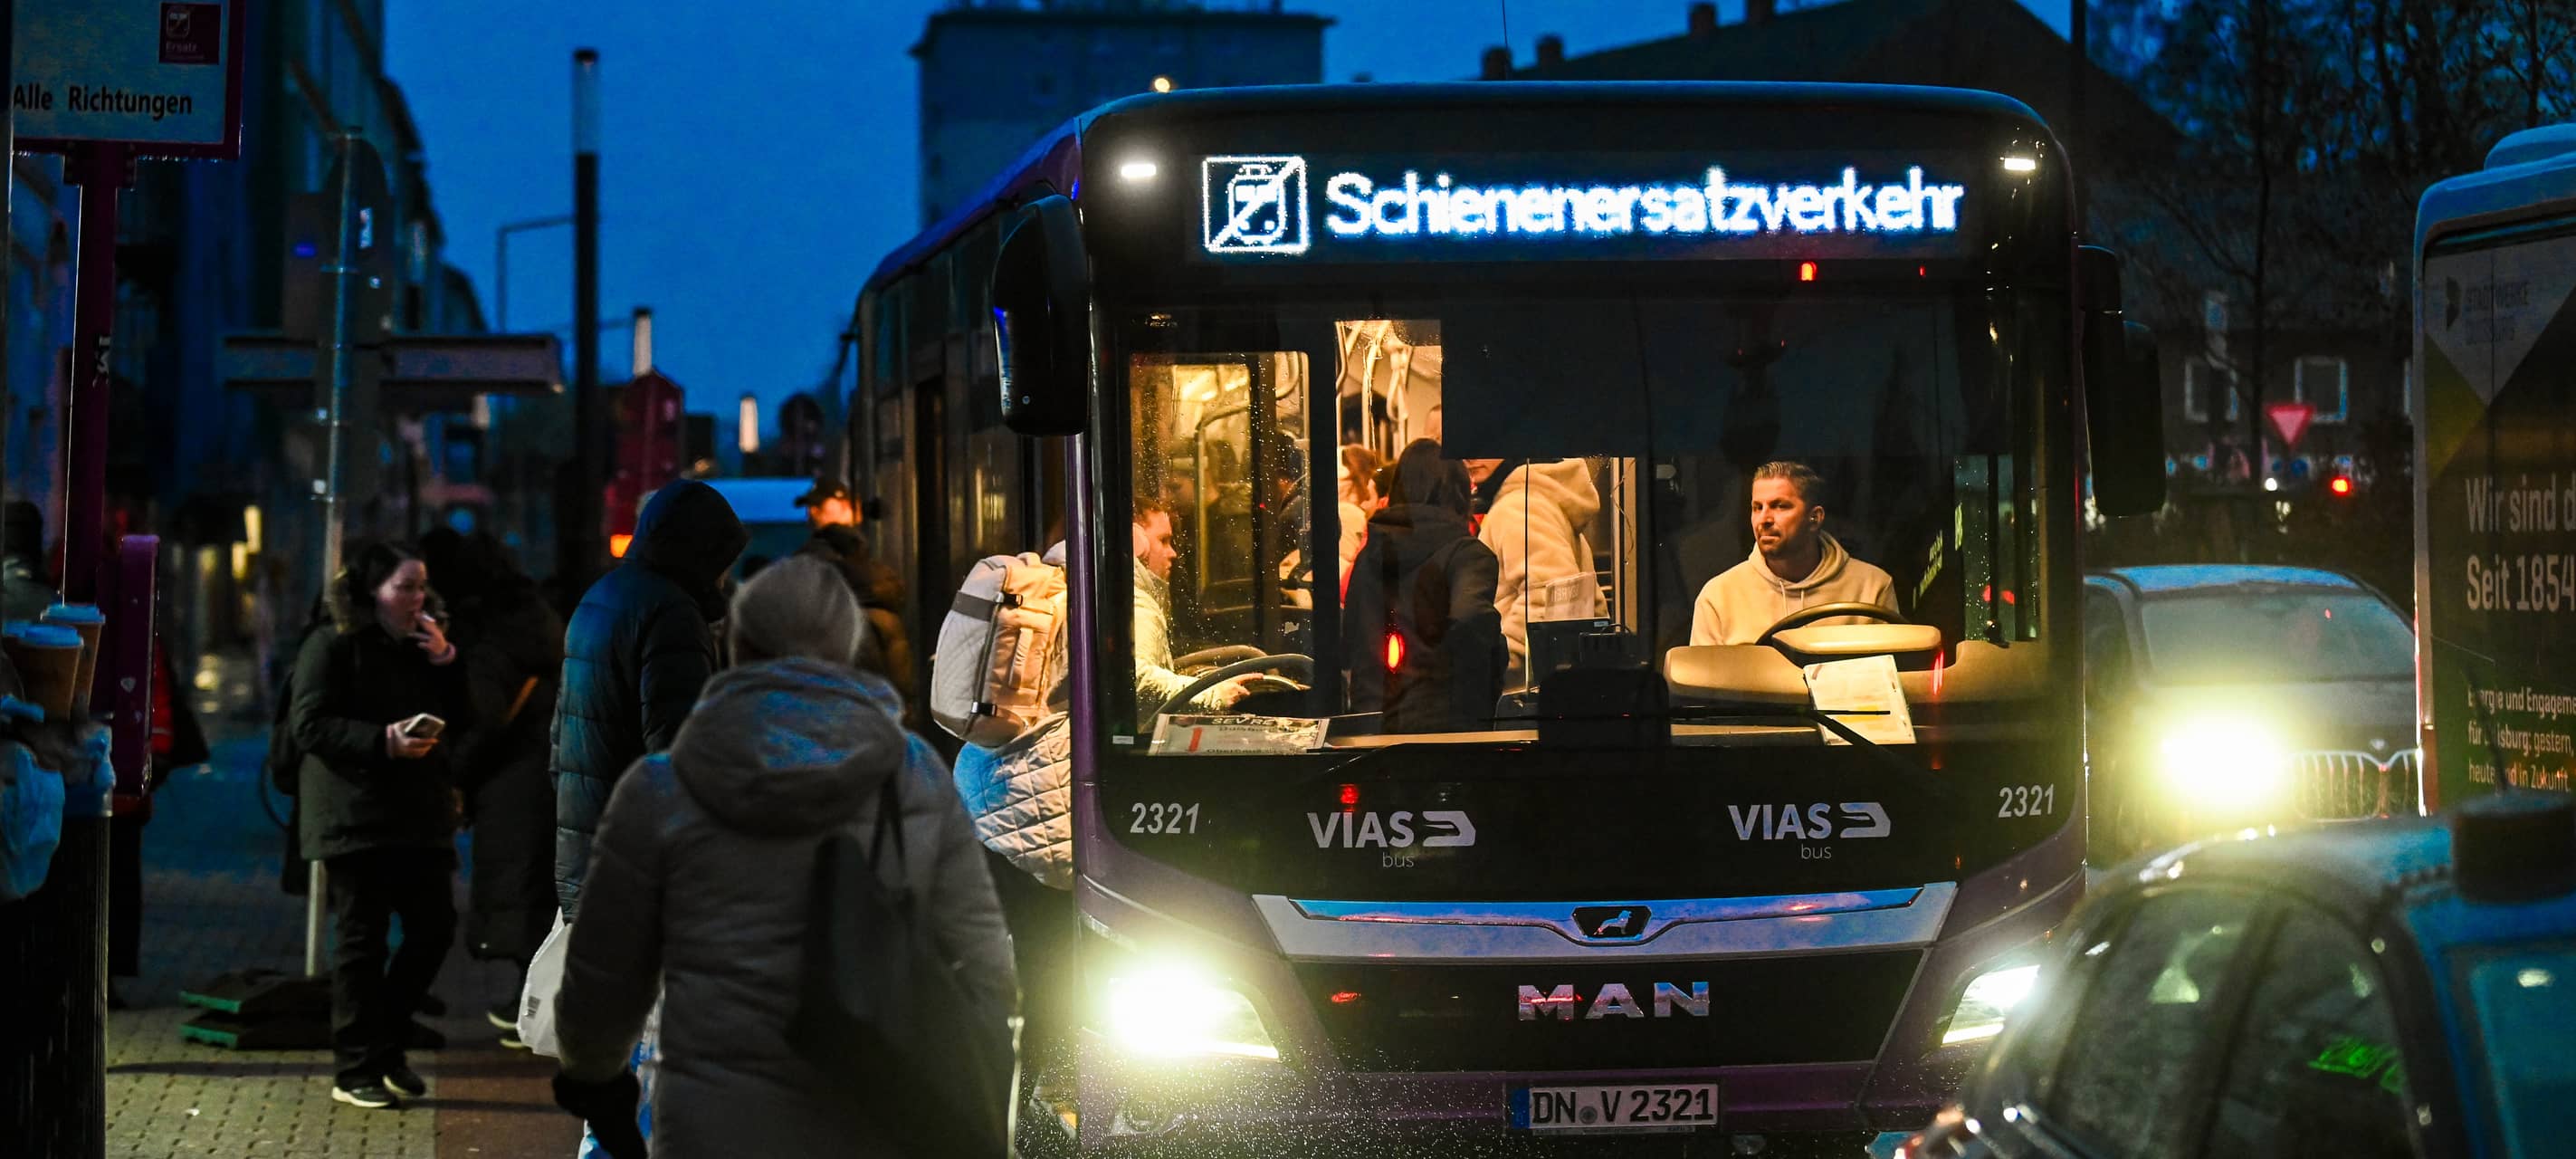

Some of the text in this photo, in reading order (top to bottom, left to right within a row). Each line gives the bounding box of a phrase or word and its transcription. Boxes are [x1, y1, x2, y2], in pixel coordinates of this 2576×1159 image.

[13, 82, 193, 121] Alle Richtungen
[1325, 166, 1964, 234] Schienenersatzverkehr
[2465, 475, 2504, 532] Wir
[2509, 473, 2556, 532] sind
[2466, 553, 2576, 612] Seit 1854
[2505, 686, 2524, 711] und
[1212, 717, 1250, 725] SEV
[2468, 719, 2482, 745] für
[2533, 730, 2574, 757] gestern,
[2468, 758, 2495, 784] heute
[2519, 762, 2529, 788] in
[1130, 802, 1200, 834] 2321
[1998, 783, 2055, 818] 2321
[1307, 810, 1415, 848] VIAS
[1728, 802, 1832, 840] VIAS
[1382, 852, 1415, 868] bus
[1800, 844, 1833, 859] bus
[1518, 982, 1710, 1021] MAN
[1531, 1091, 1577, 1124] DN
[1600, 1090, 1622, 1123] V
[1630, 1088, 1714, 1122] 2321
